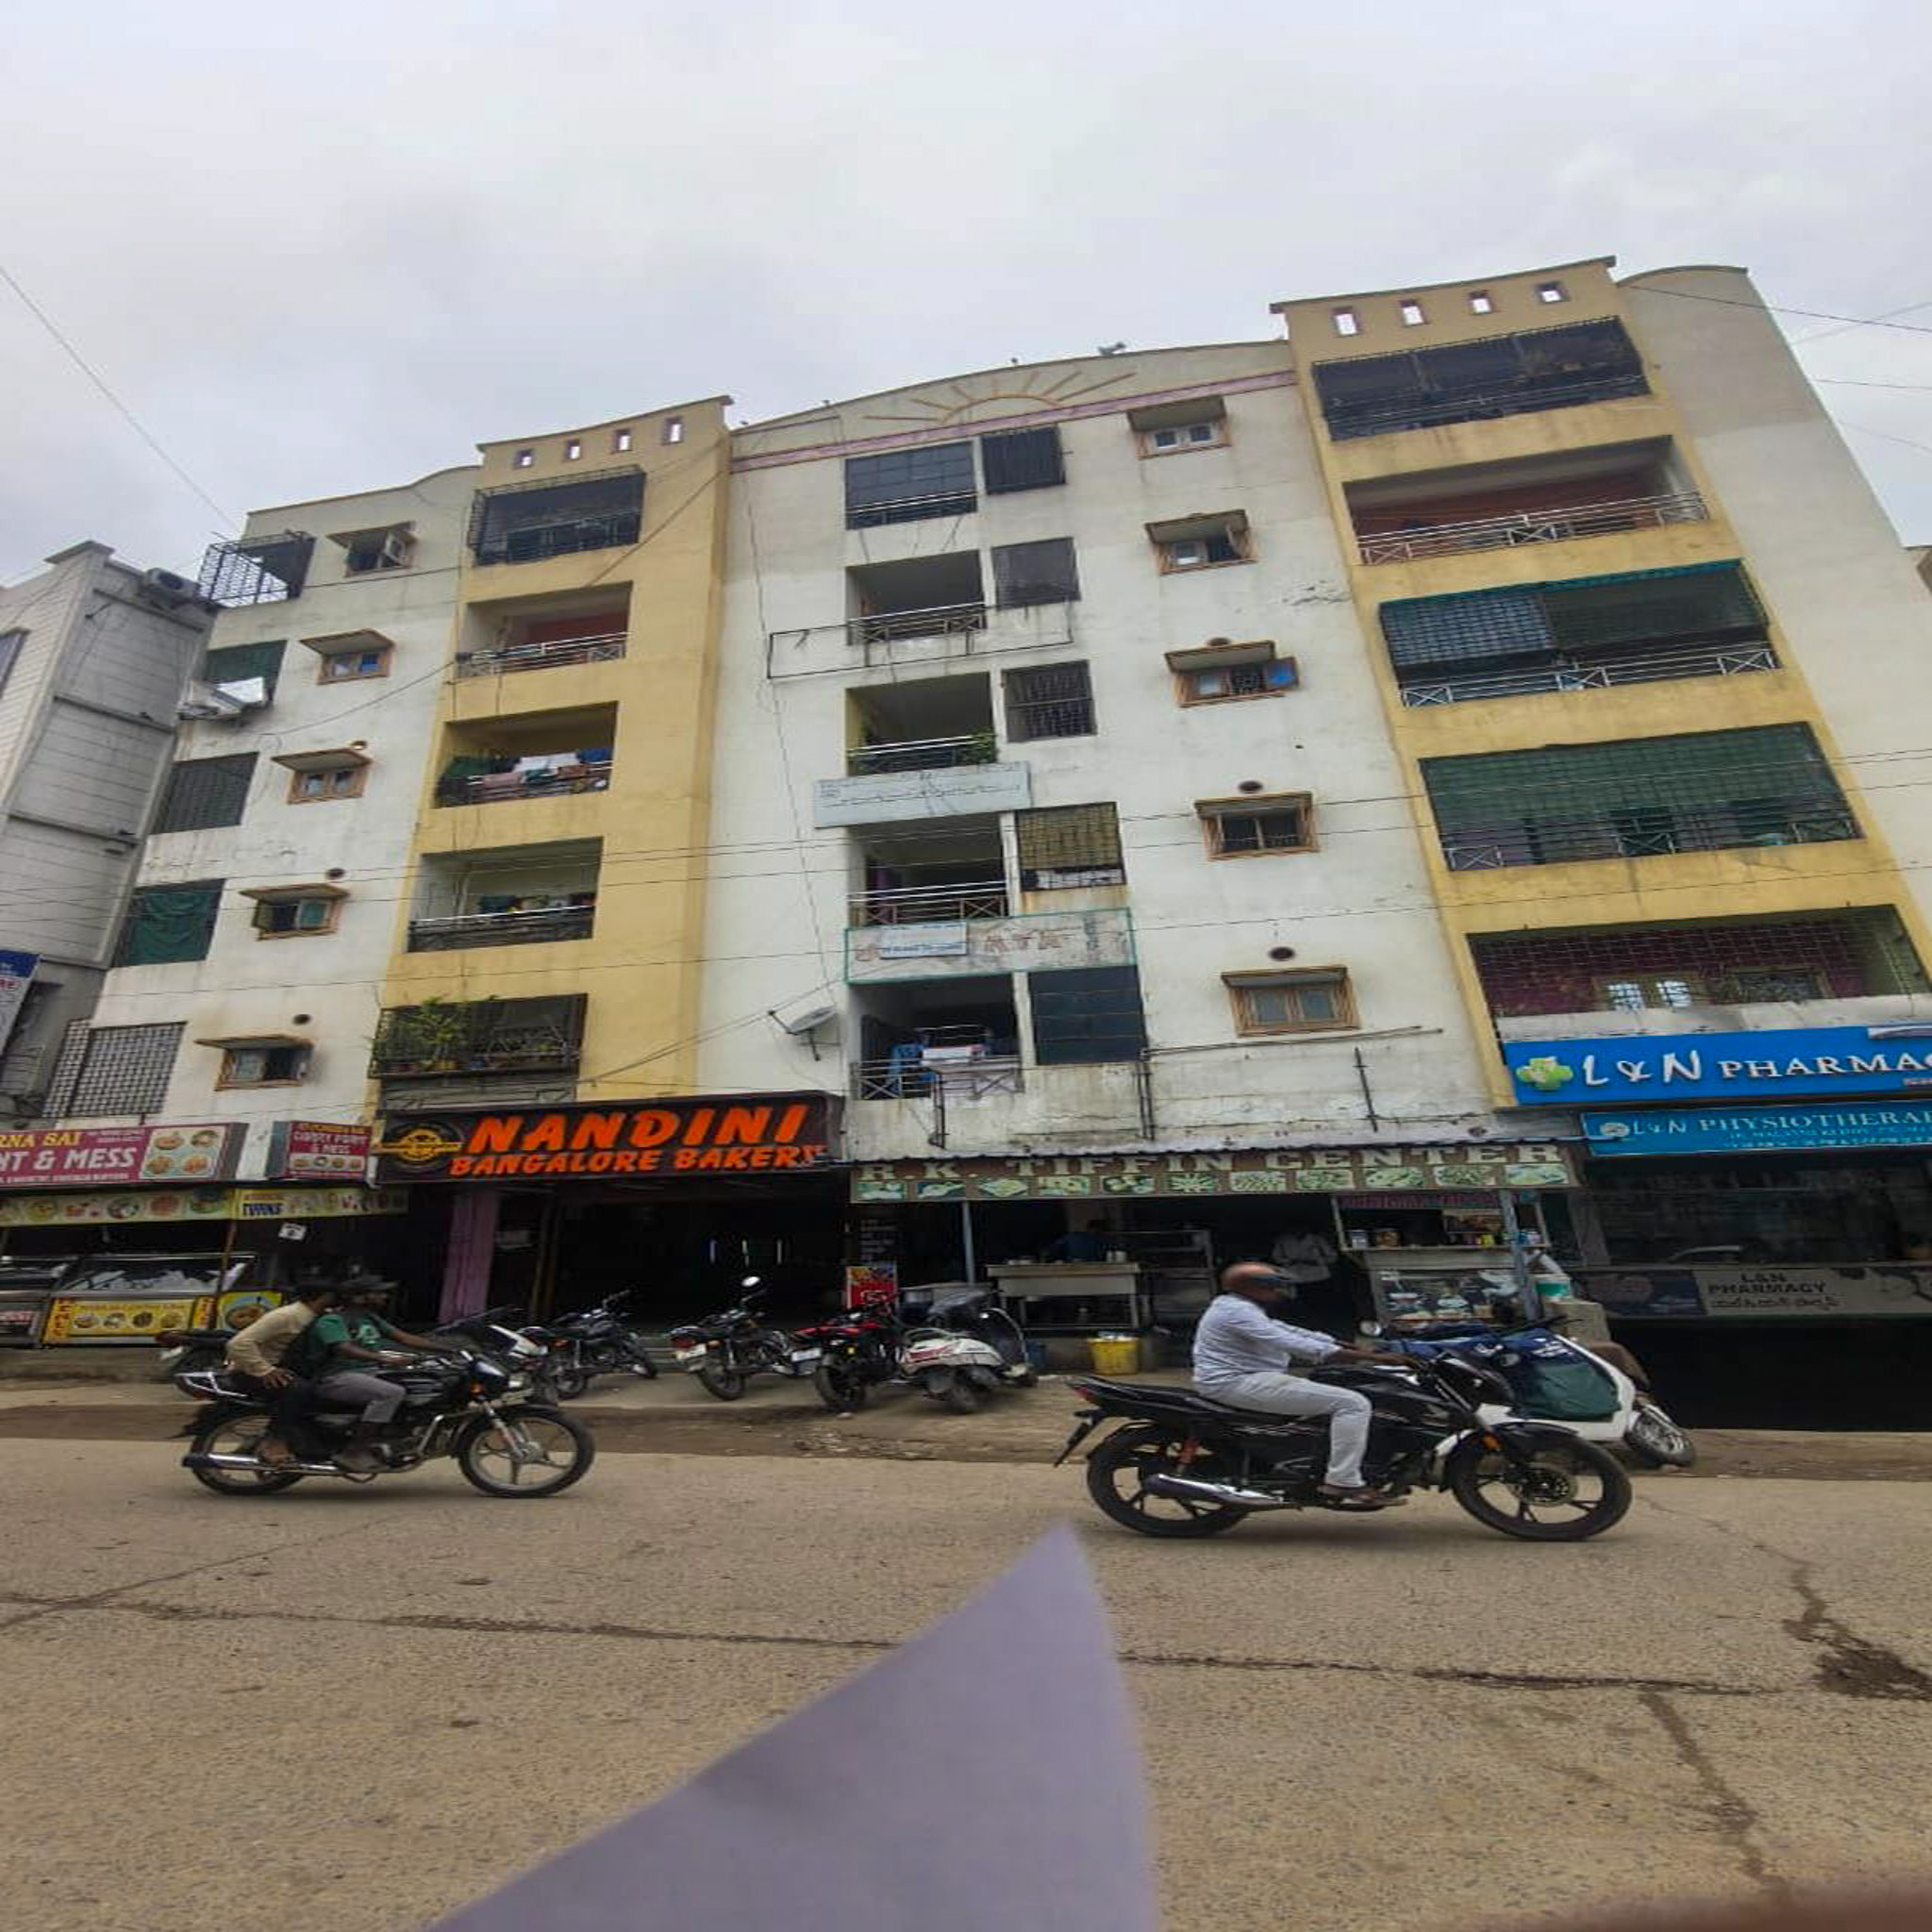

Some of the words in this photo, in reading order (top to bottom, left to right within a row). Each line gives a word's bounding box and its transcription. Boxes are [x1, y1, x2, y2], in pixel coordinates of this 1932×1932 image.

[1583, 1054, 1609, 1085] L
[1662, 1049, 1702, 1083] N
[1717, 1051, 1932, 1079] PHARMA
[467, 1104, 809, 1154] NANDINI
[34, 1150, 56, 1170] &
[64, 1147, 138, 1169] MESS
[449, 1149, 662, 1175] BANGALORE
[1006, 1152, 1234, 1177] TIFFIN
[1265, 1144, 1564, 1171] CENTER
